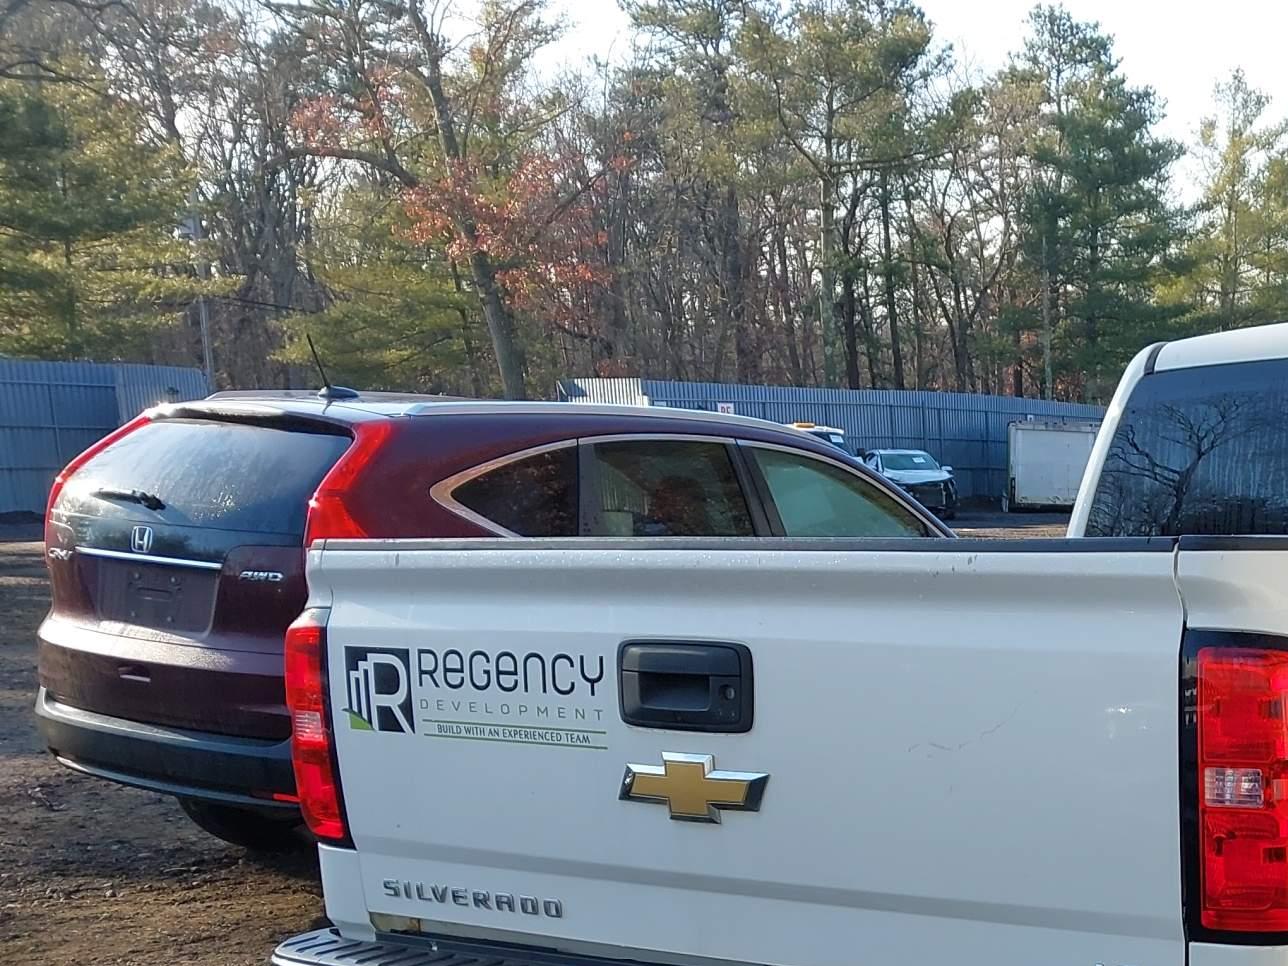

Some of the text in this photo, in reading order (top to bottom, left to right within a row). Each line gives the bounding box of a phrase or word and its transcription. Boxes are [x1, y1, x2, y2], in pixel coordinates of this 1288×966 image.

[239, 570, 285, 582] AWD
[419, 698, 604, 721] DEVELOPMENT
[436, 723, 591, 744] BUILD WITH AN EXPERIENCED TEAM
[383, 878, 564, 918] SILVERADO
